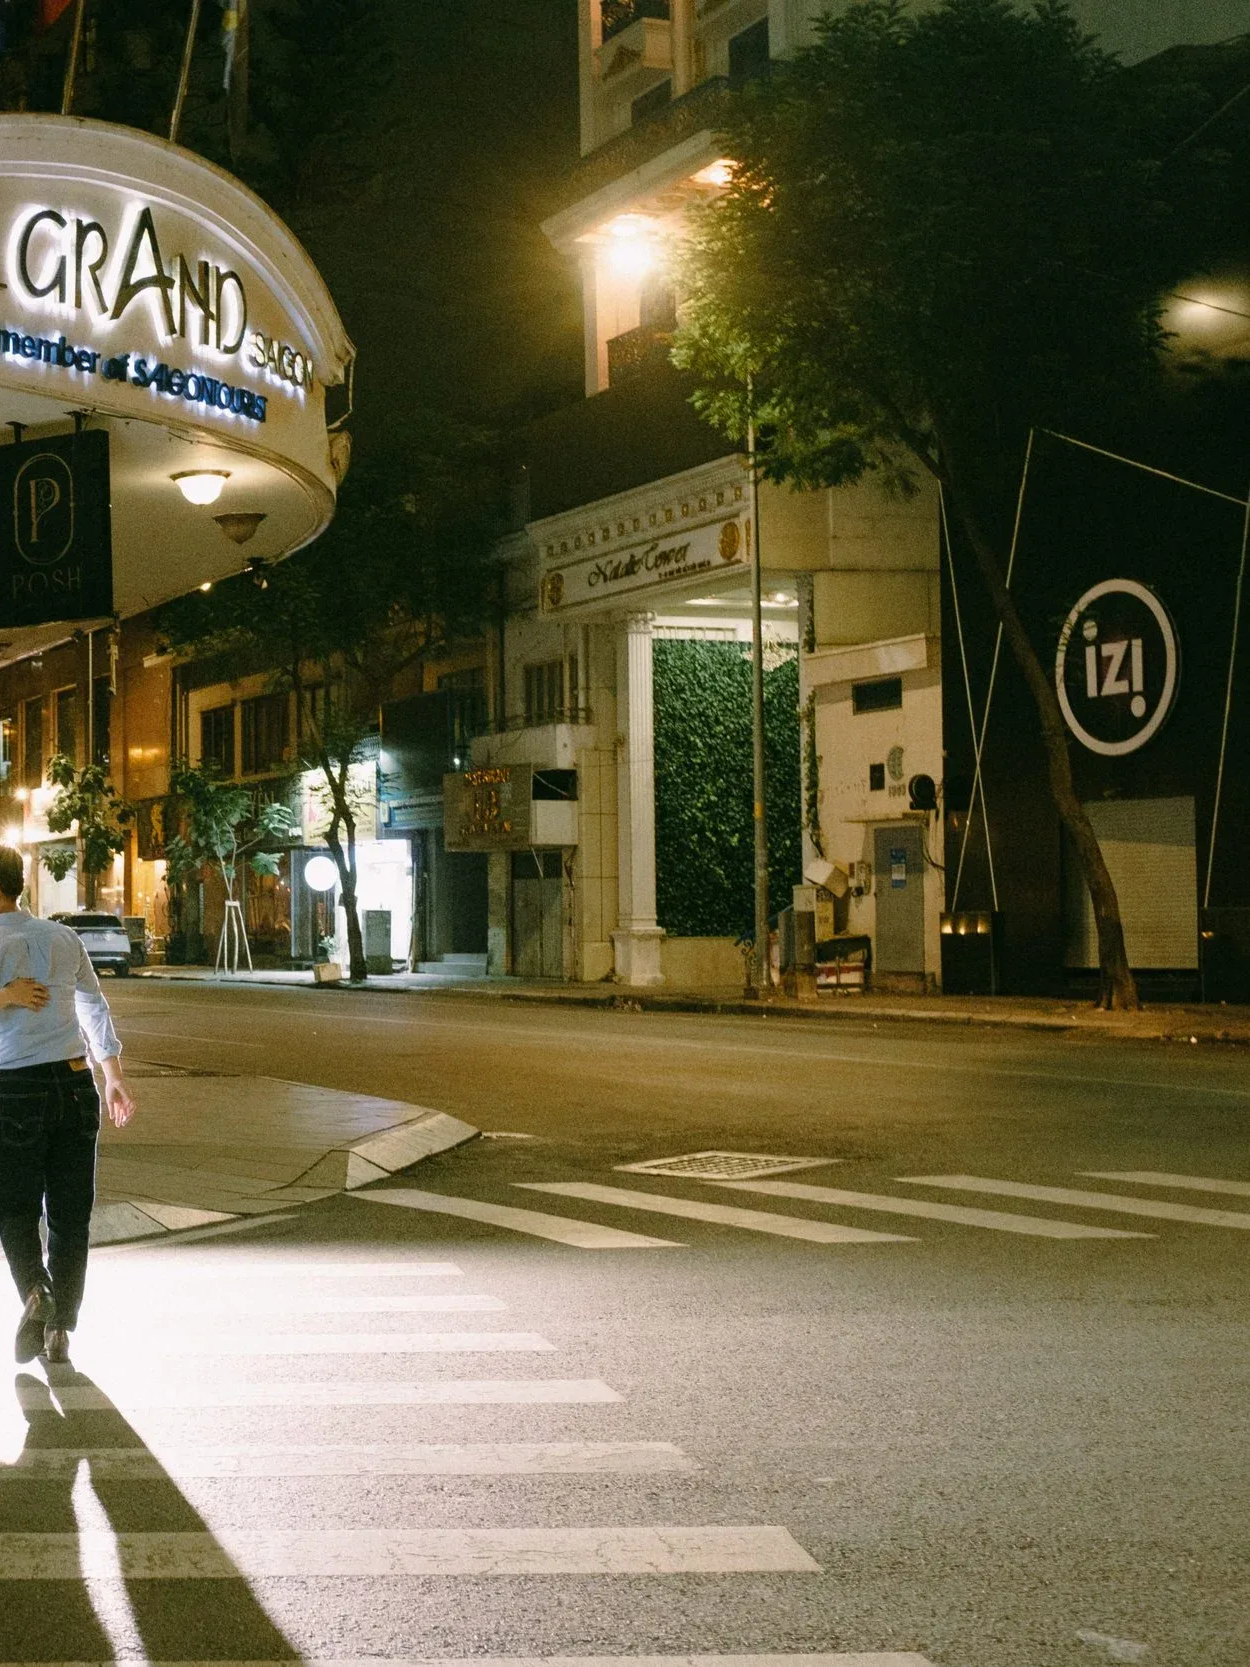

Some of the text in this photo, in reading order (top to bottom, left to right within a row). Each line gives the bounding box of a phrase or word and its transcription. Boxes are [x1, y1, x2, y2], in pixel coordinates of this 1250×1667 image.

[18, 206, 247, 355] GRAND
[247, 331, 314, 392] SAIGON
[101, 352, 130, 382] of
[29, 477, 61, 542] P
[11, 566, 82, 599] POSH
